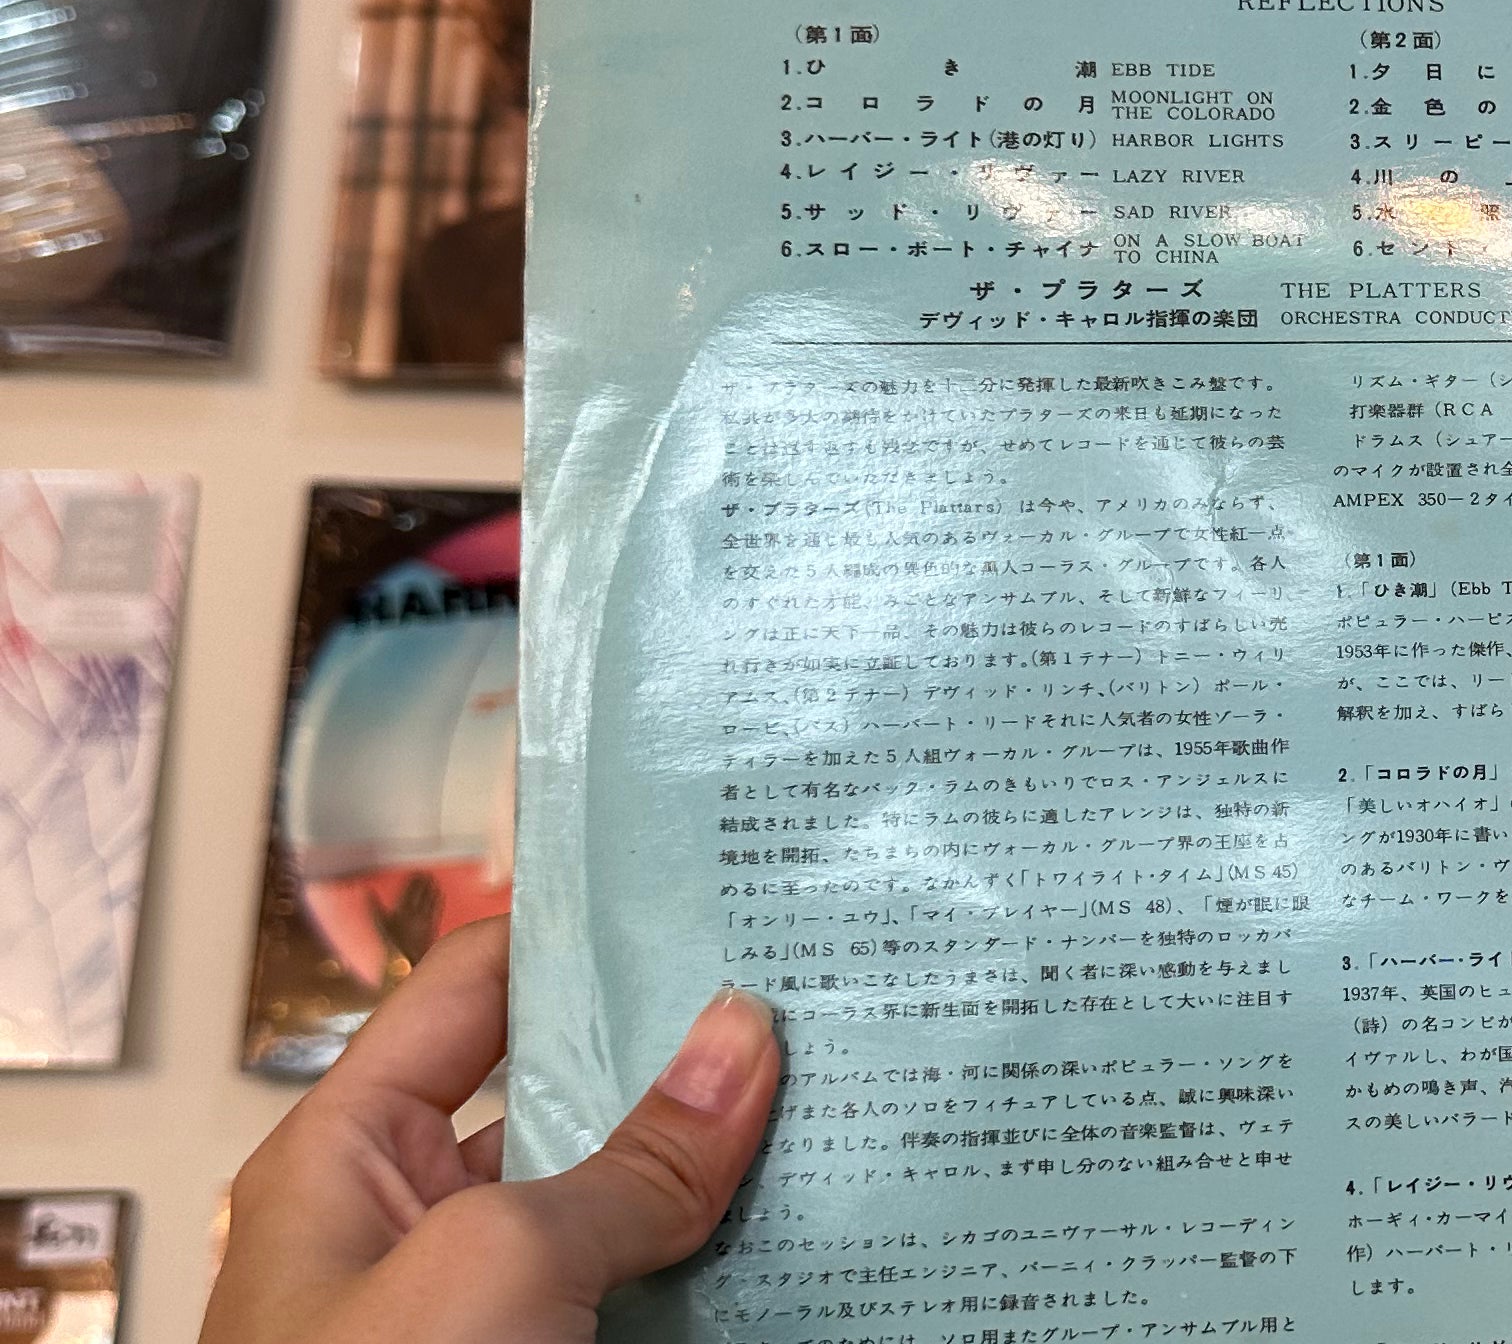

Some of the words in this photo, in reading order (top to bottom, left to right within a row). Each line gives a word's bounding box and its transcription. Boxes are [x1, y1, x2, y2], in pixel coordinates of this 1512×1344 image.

[796, 24, 879, 44] (第1面)
[1361, 30, 1441, 49] (第2面)
[1112, 63, 1151, 76] EBB
[1166, 64, 1215, 77] TIDE
[1112, 90, 1233, 104] MOONLIGHT
[1247, 91, 1273, 104] ON
[1112, 106, 1152, 119] THE
[1167, 107, 1275, 121] COLORADO
[1112, 134, 1194, 147] HARBOR
[1209, 134, 1283, 147] LIGHTS
[1113, 170, 1167, 183] LAZY
[1182, 170, 1245, 183] RIVER
[1113, 205, 1154, 219] SAD
[1169, 204, 1231, 220] RIVER
[1113, 233, 1141, 248] ON
[1155, 233, 1170, 247] A
[1183, 233, 1239, 248] SLOW
[1251, 233, 1305, 248] BOAT
[1113, 250, 1140, 264] TO
[1156, 250, 1219, 264] CHINA
[969, 278, 1203, 301] ザ・プラターズ
[1281, 282, 1331, 299] THE
[1349, 282, 1480, 298] PLATTERS
[920, 309, 1258, 330] デヴィッド・キャロル指揮の楽団
[1281, 311, 1402, 326] ORCHESTRA
[1332, 493, 1404, 507] AMPEX
[1451, 581, 1490, 597] (Ebb
